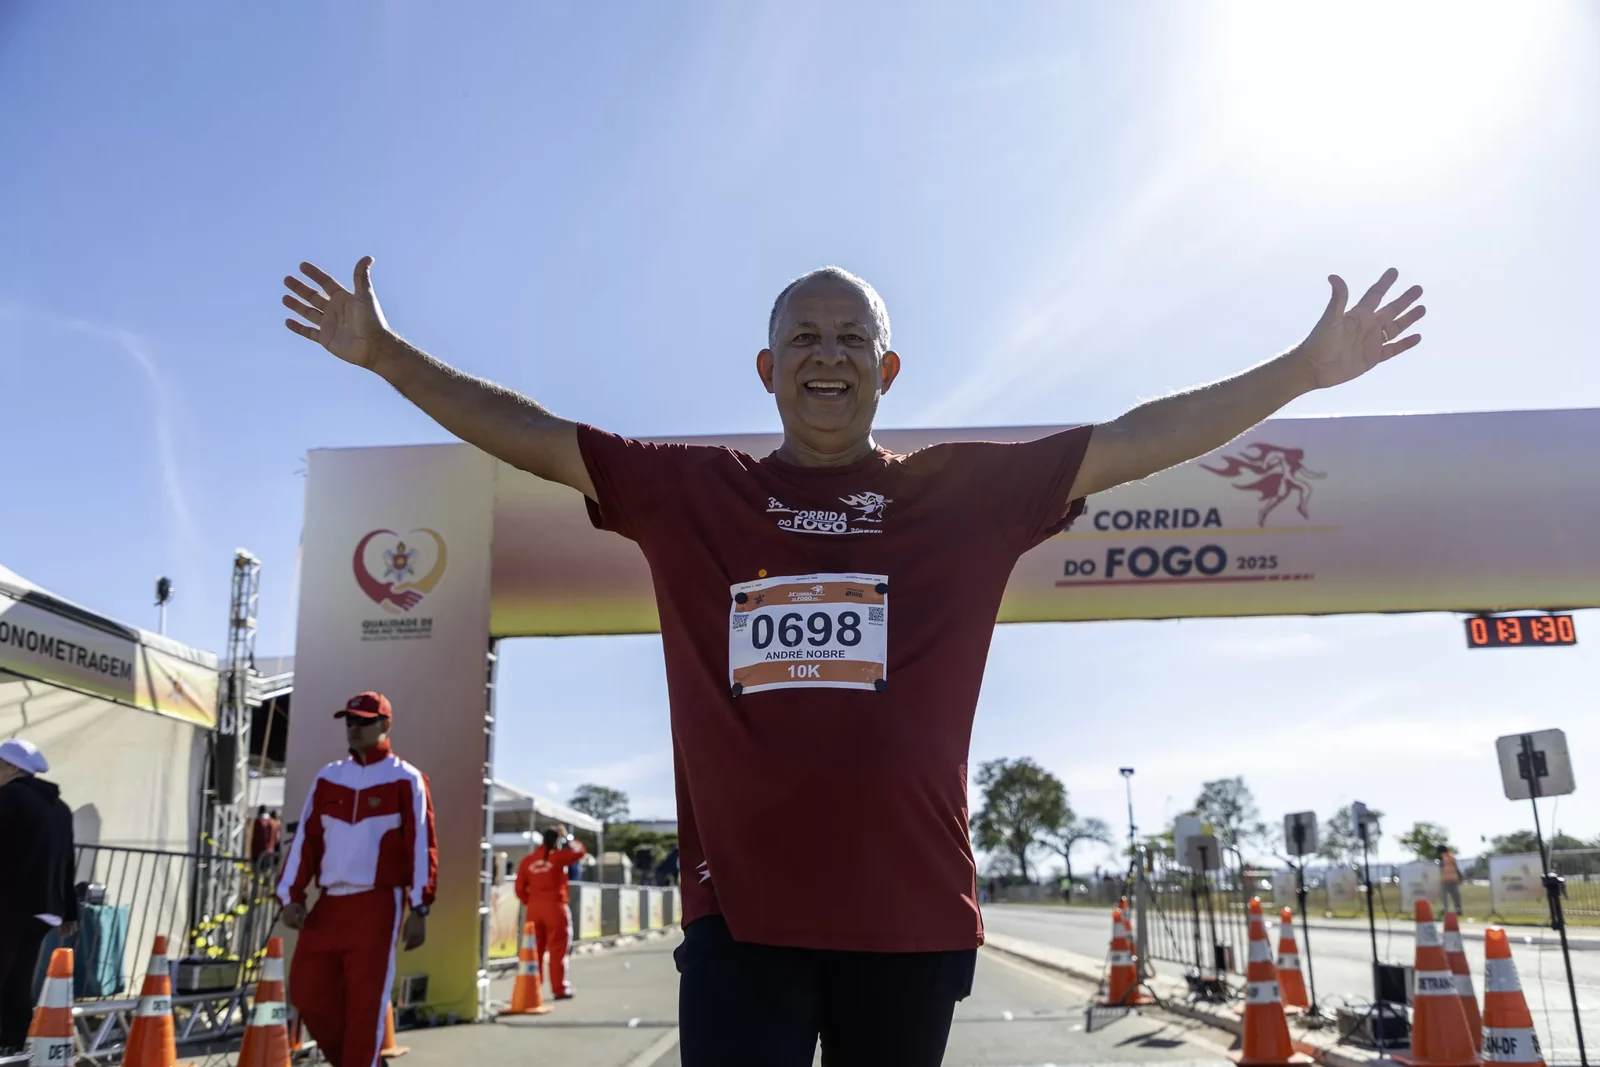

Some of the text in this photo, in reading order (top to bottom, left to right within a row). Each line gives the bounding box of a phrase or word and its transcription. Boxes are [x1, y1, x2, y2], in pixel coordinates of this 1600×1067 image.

[777, 519, 792, 527] DO
[793, 515, 847, 533] FOGO
[792, 509, 848, 522] ORRIDA
[1093, 507, 1223, 532] CORRIDA
[1063, 544, 1278, 579] DO FOGO 2025
[751, 611, 862, 649] 0698
[765, 649, 845, 660] ANDRÉ NOBRE
[788, 664, 821, 679] 10K
